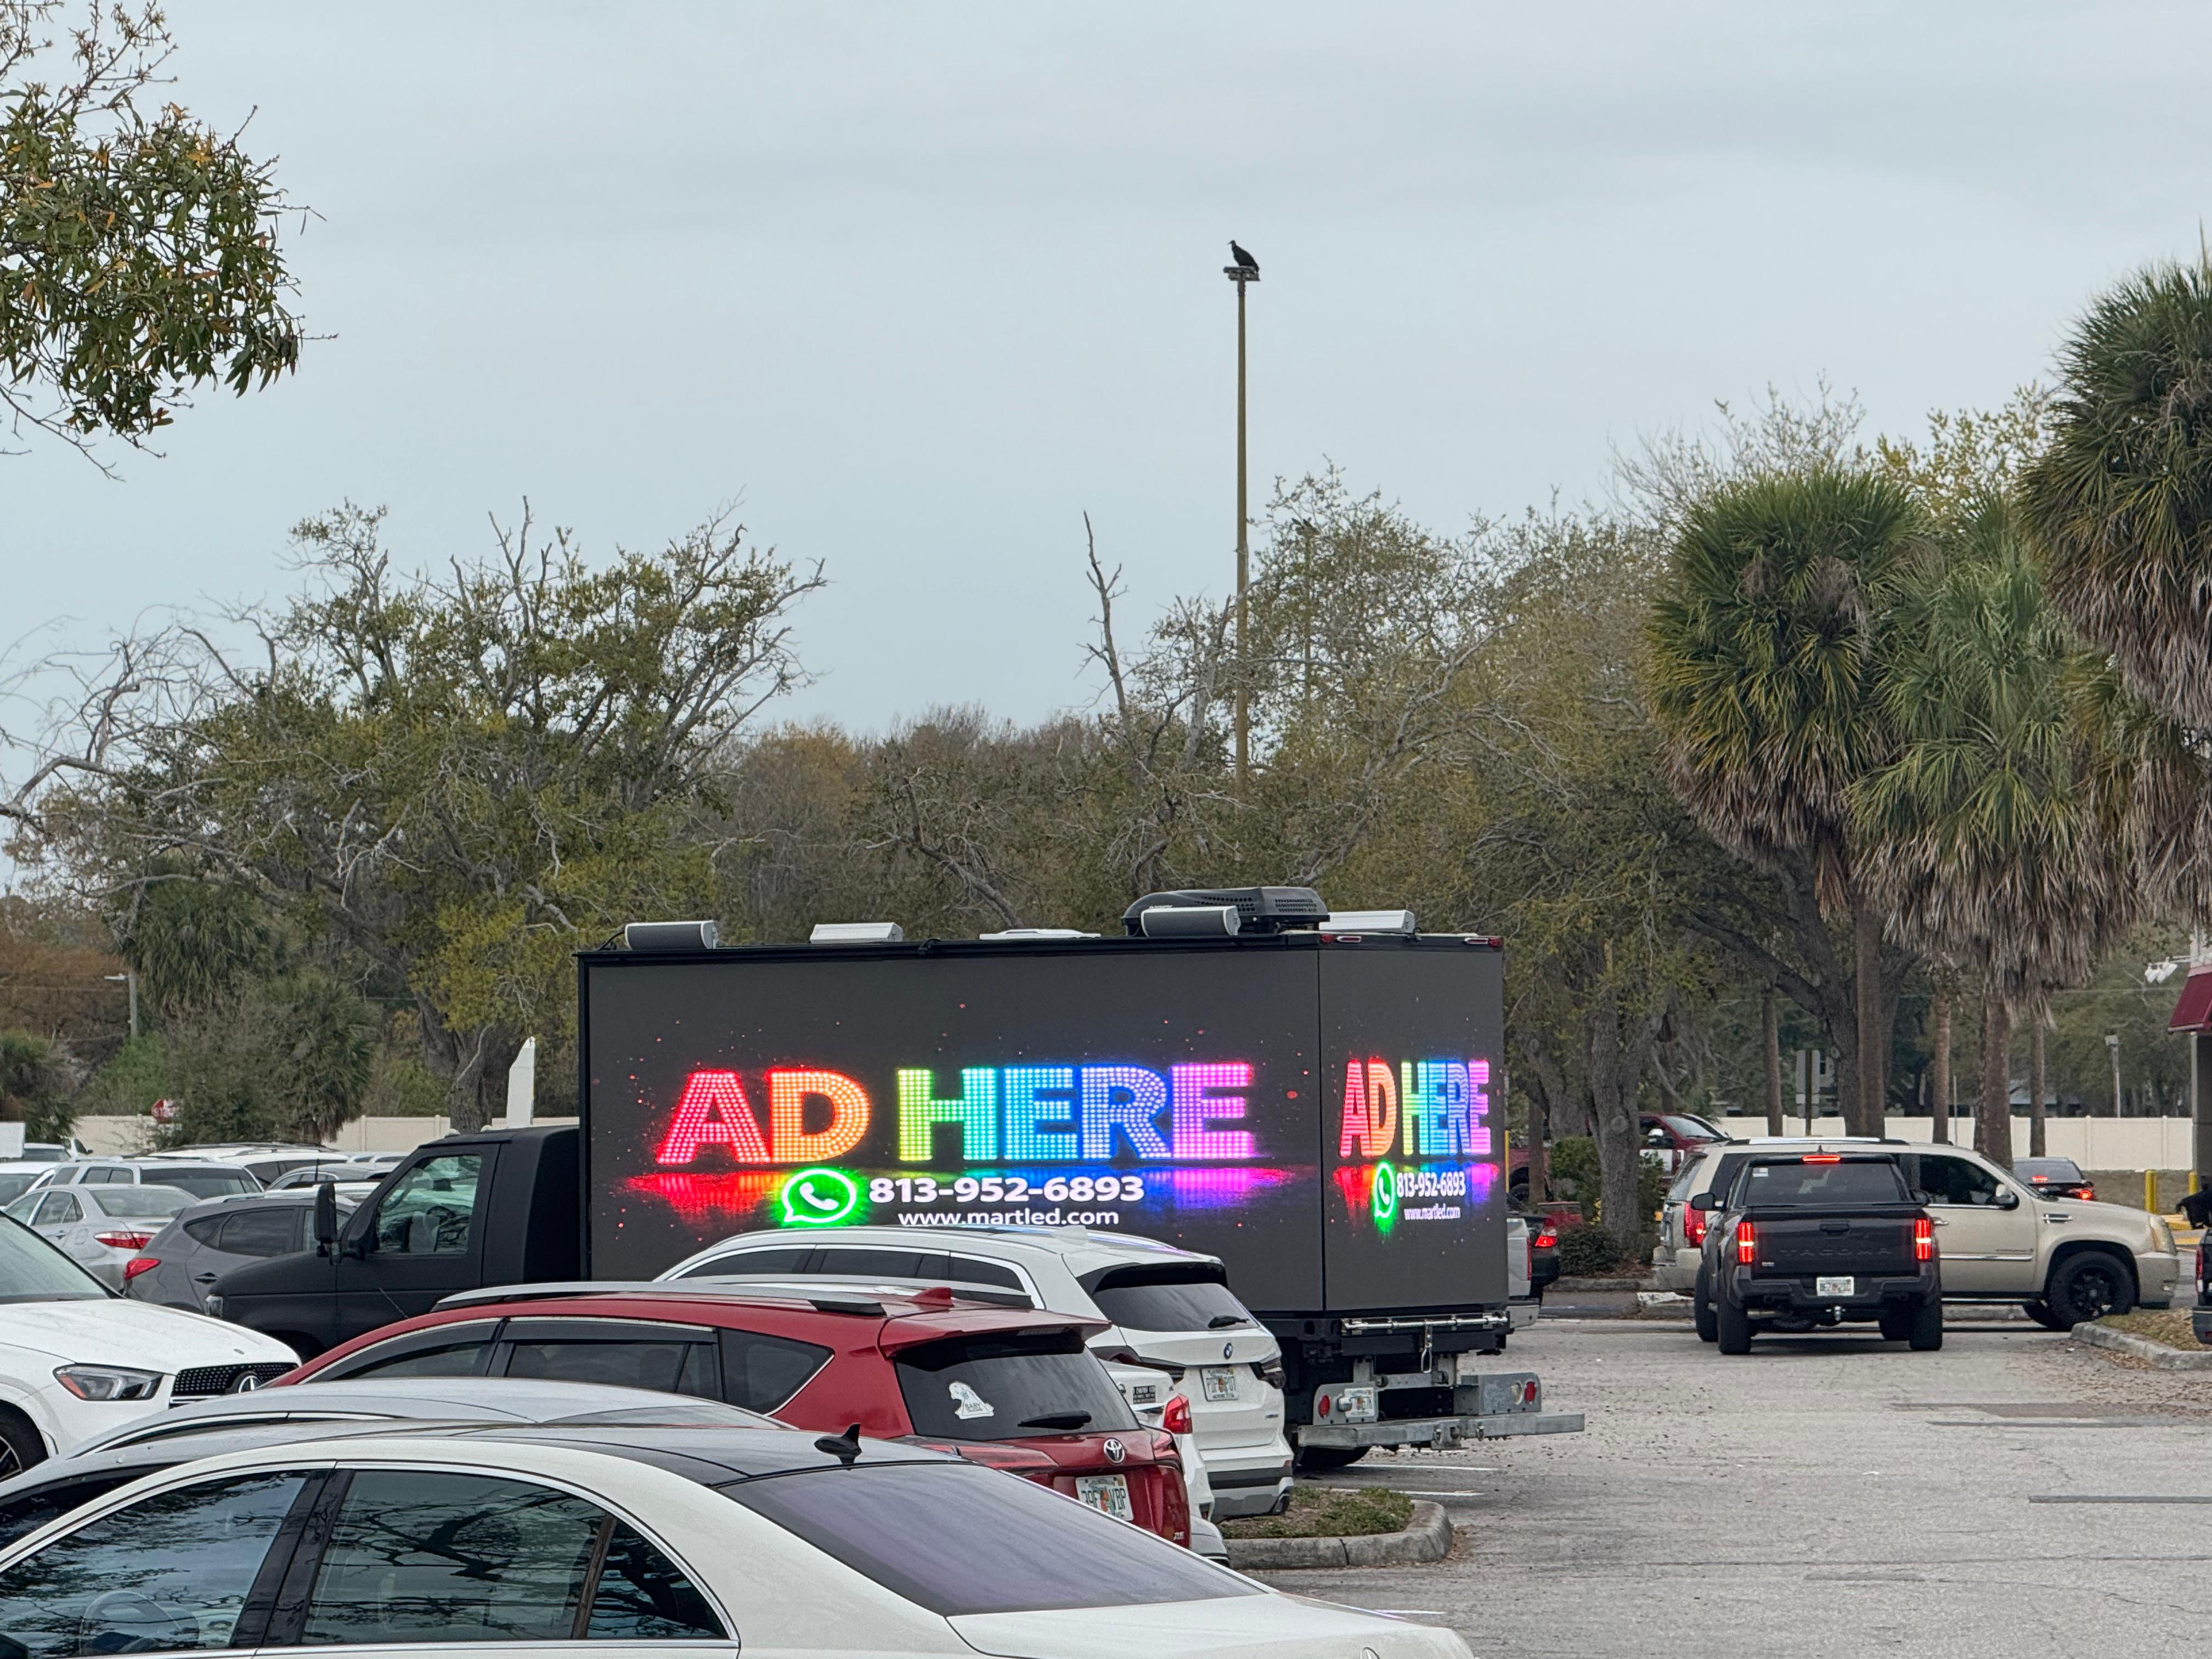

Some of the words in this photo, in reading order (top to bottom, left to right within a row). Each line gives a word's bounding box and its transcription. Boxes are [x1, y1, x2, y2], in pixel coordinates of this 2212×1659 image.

[656, 1069, 871, 1163] AD
[896, 1061, 1254, 1162] HERE
[1339, 1060, 1397, 1158] AD
[1401, 1060, 1491, 1155] HERE
[868, 1176, 1145, 1203] 813-952-6893
[1396, 1172, 1466, 1197] 813-952-6893
[898, 1208, 1119, 1226] www.martled.com
[1404, 1204, 1460, 1220] www.martled.com
